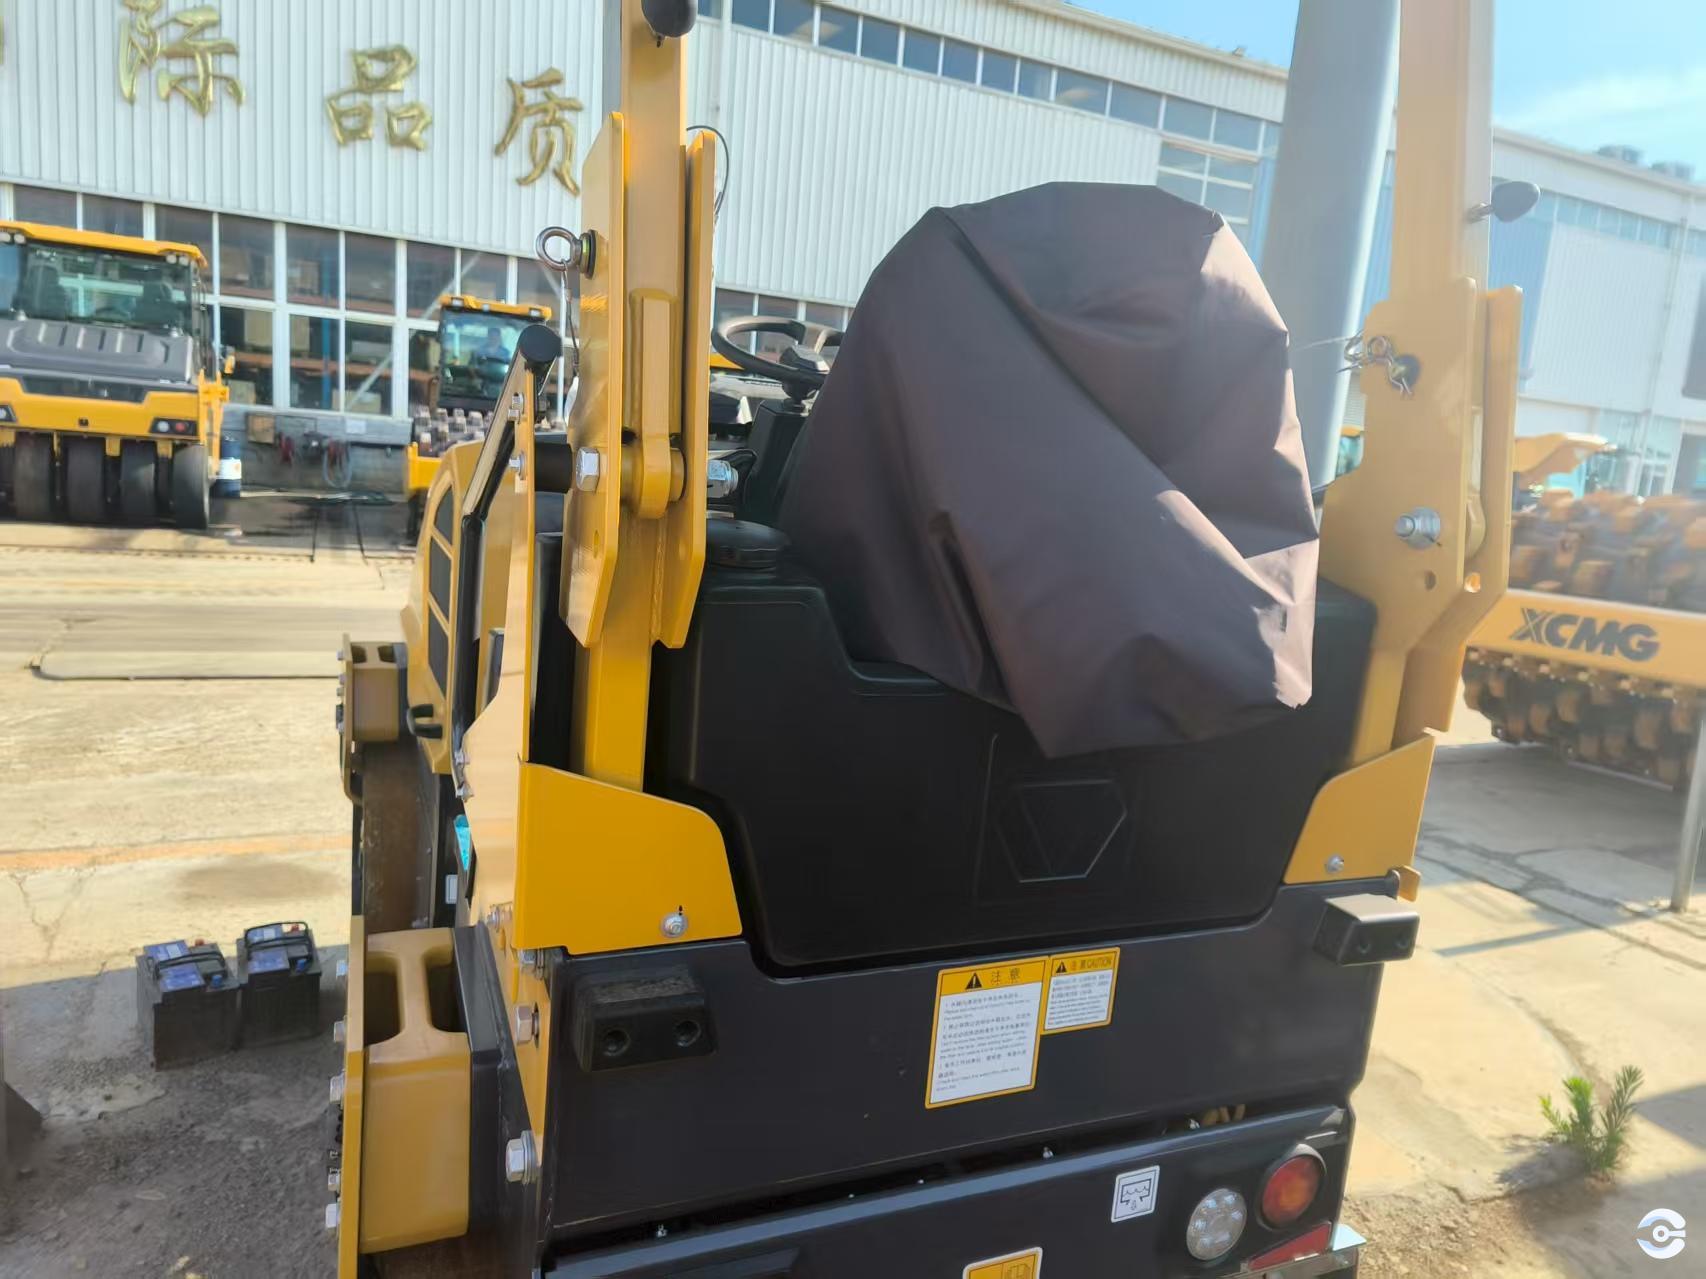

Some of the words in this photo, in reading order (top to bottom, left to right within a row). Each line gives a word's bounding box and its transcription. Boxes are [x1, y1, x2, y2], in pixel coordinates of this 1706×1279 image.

[0, 0, 584, 196] 际品质
[1509, 607, 1660, 662] XCMG
